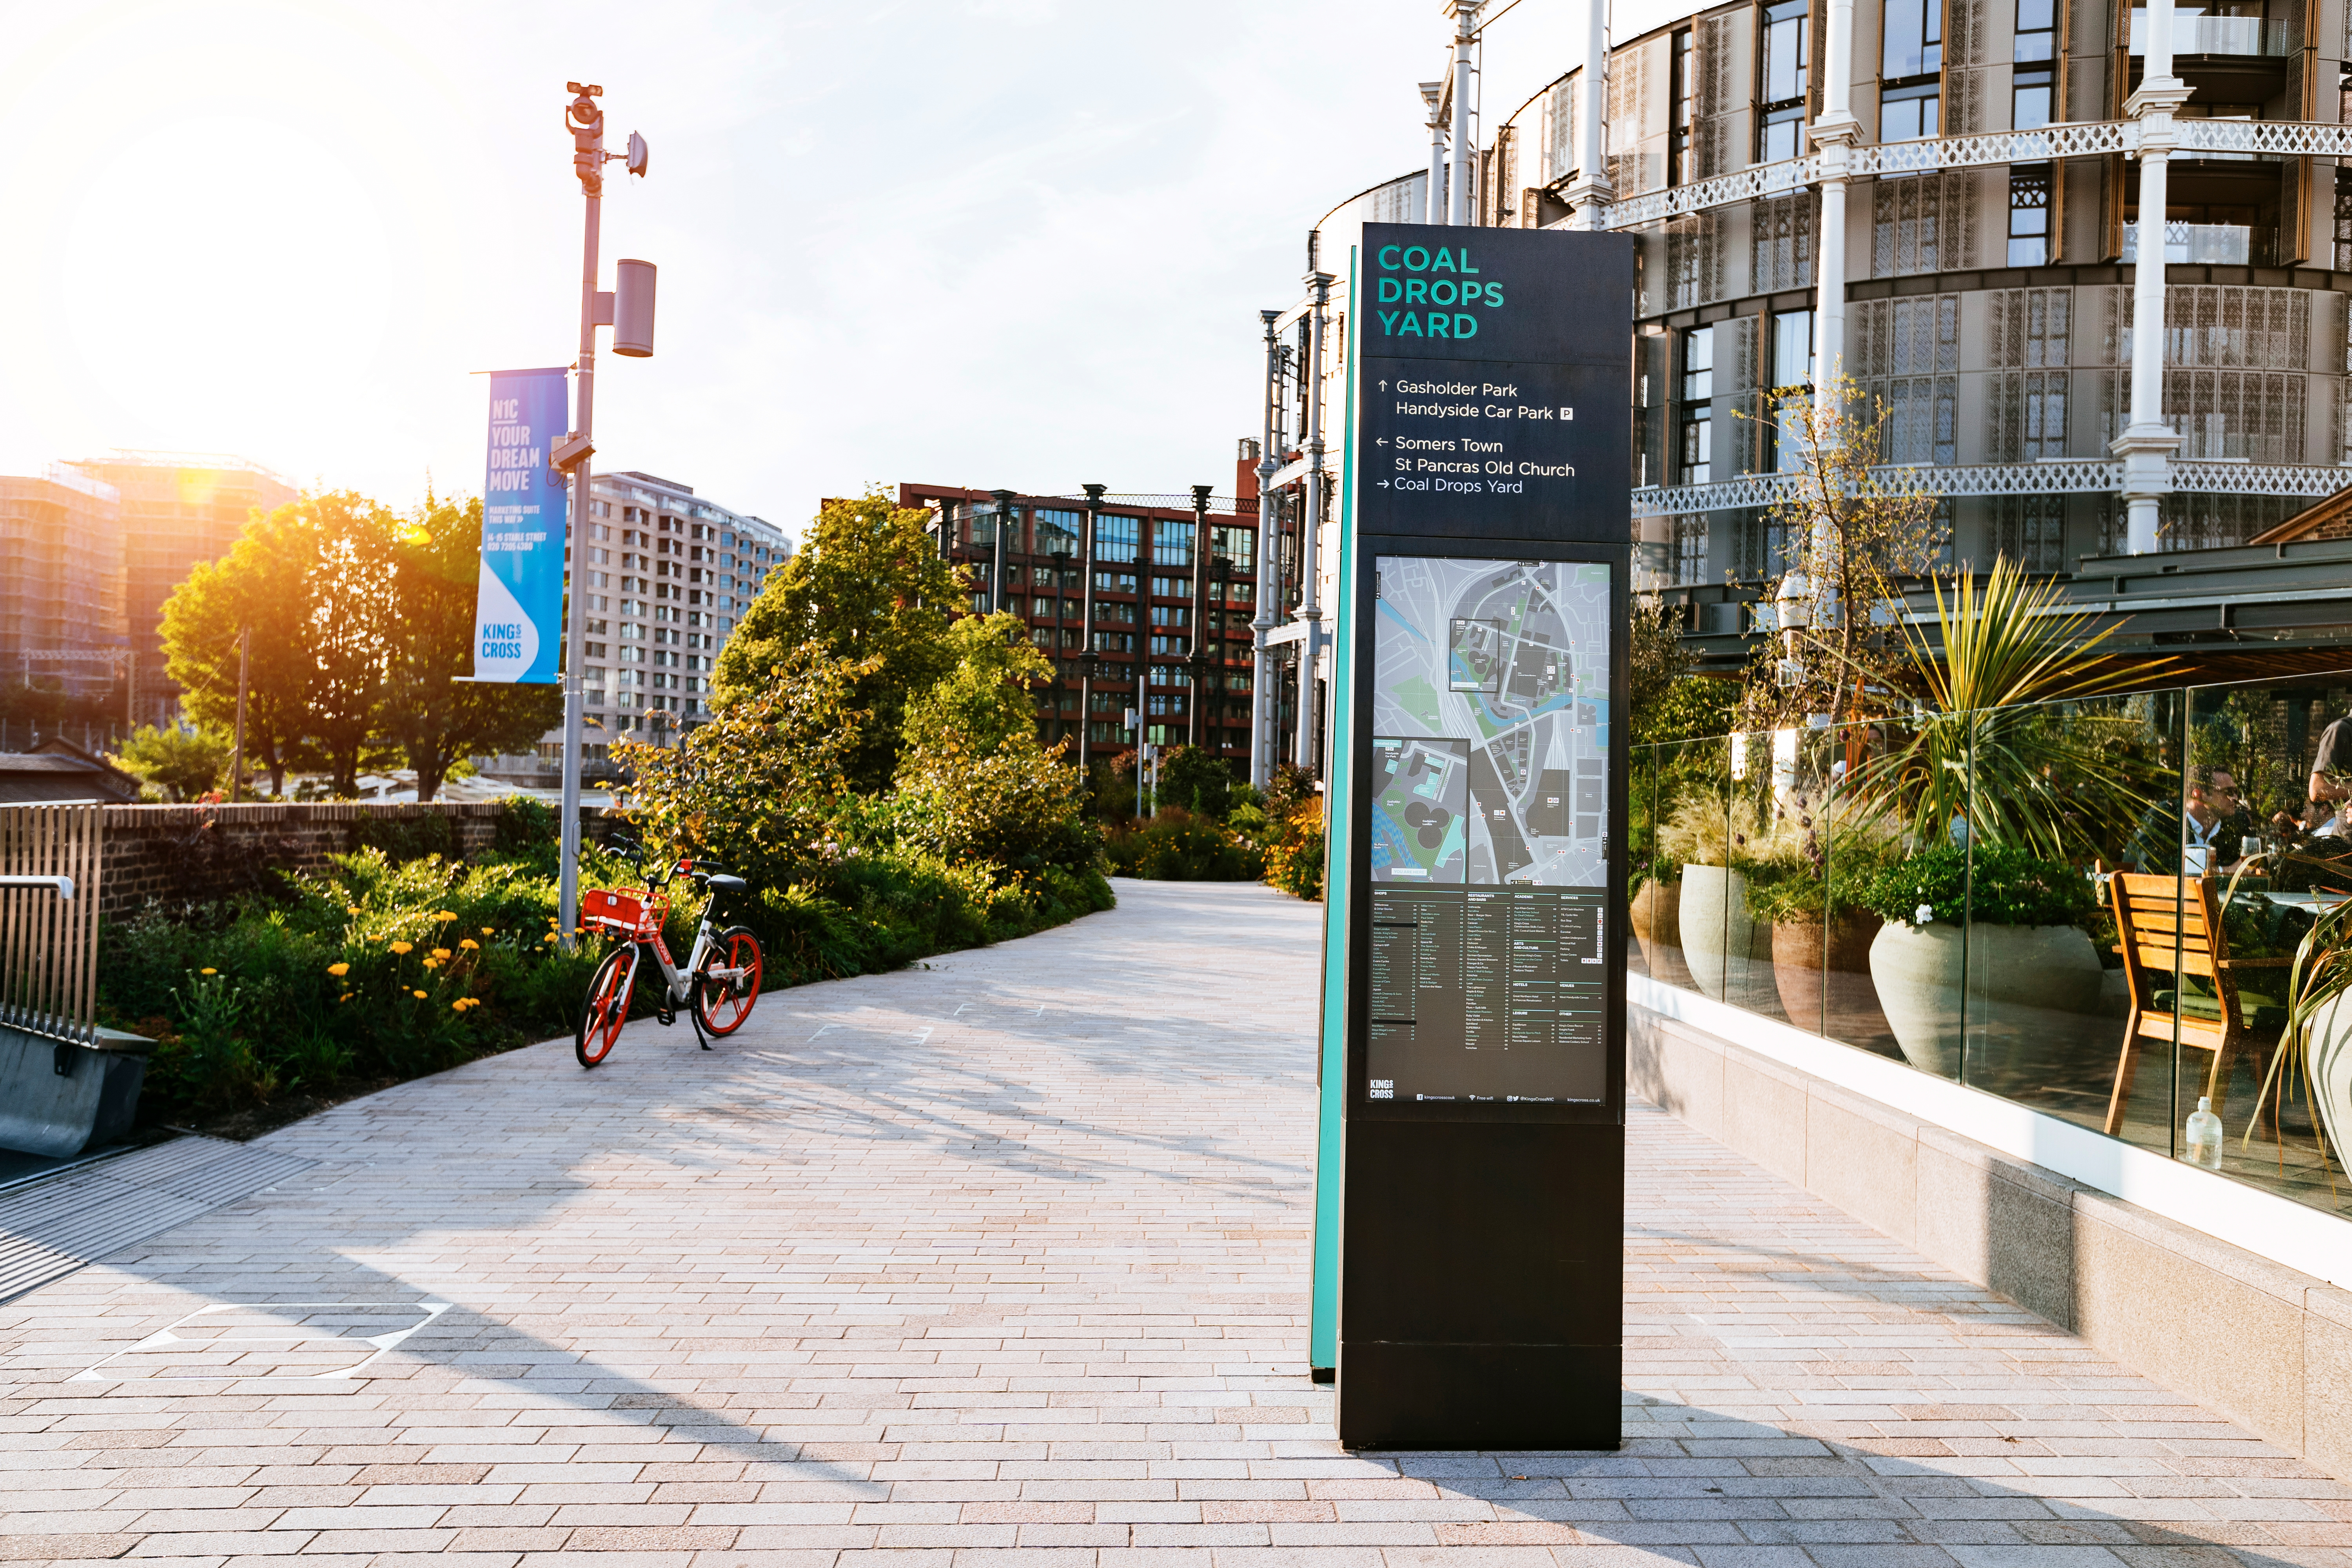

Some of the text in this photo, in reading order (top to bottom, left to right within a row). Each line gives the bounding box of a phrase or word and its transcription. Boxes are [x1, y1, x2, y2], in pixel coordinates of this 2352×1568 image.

[1378, 245, 1479, 273] COAL
[1378, 277, 1504, 307] DROPS
[1377, 310, 1477, 339] YARD
[1397, 380, 1517, 397] Gasholder Park
[493, 398, 519, 419] N1C
[1397, 402, 1479, 418] Handyside
[1485, 405, 1512, 418] Car
[1519, 406, 1553, 419] Park
[492, 425, 530, 446] YOUR
[1396, 437, 1503, 452] Somers Town
[491, 447, 540, 469] DREAM
[1395, 458, 1574, 476] St Pancras Old Church
[490, 470, 529, 492] MOVE
[1395, 477, 1522, 494] Coal Drops Yard
[488, 505, 540, 515] MARKETING SUITE
[489, 515, 516, 524] THIS WAY
[504, 532, 525, 542] STABLE
[525, 532, 547, 542] STREET
[483, 642, 521, 659] CROSS
[1370, 1089, 1393, 1098] CROSS
